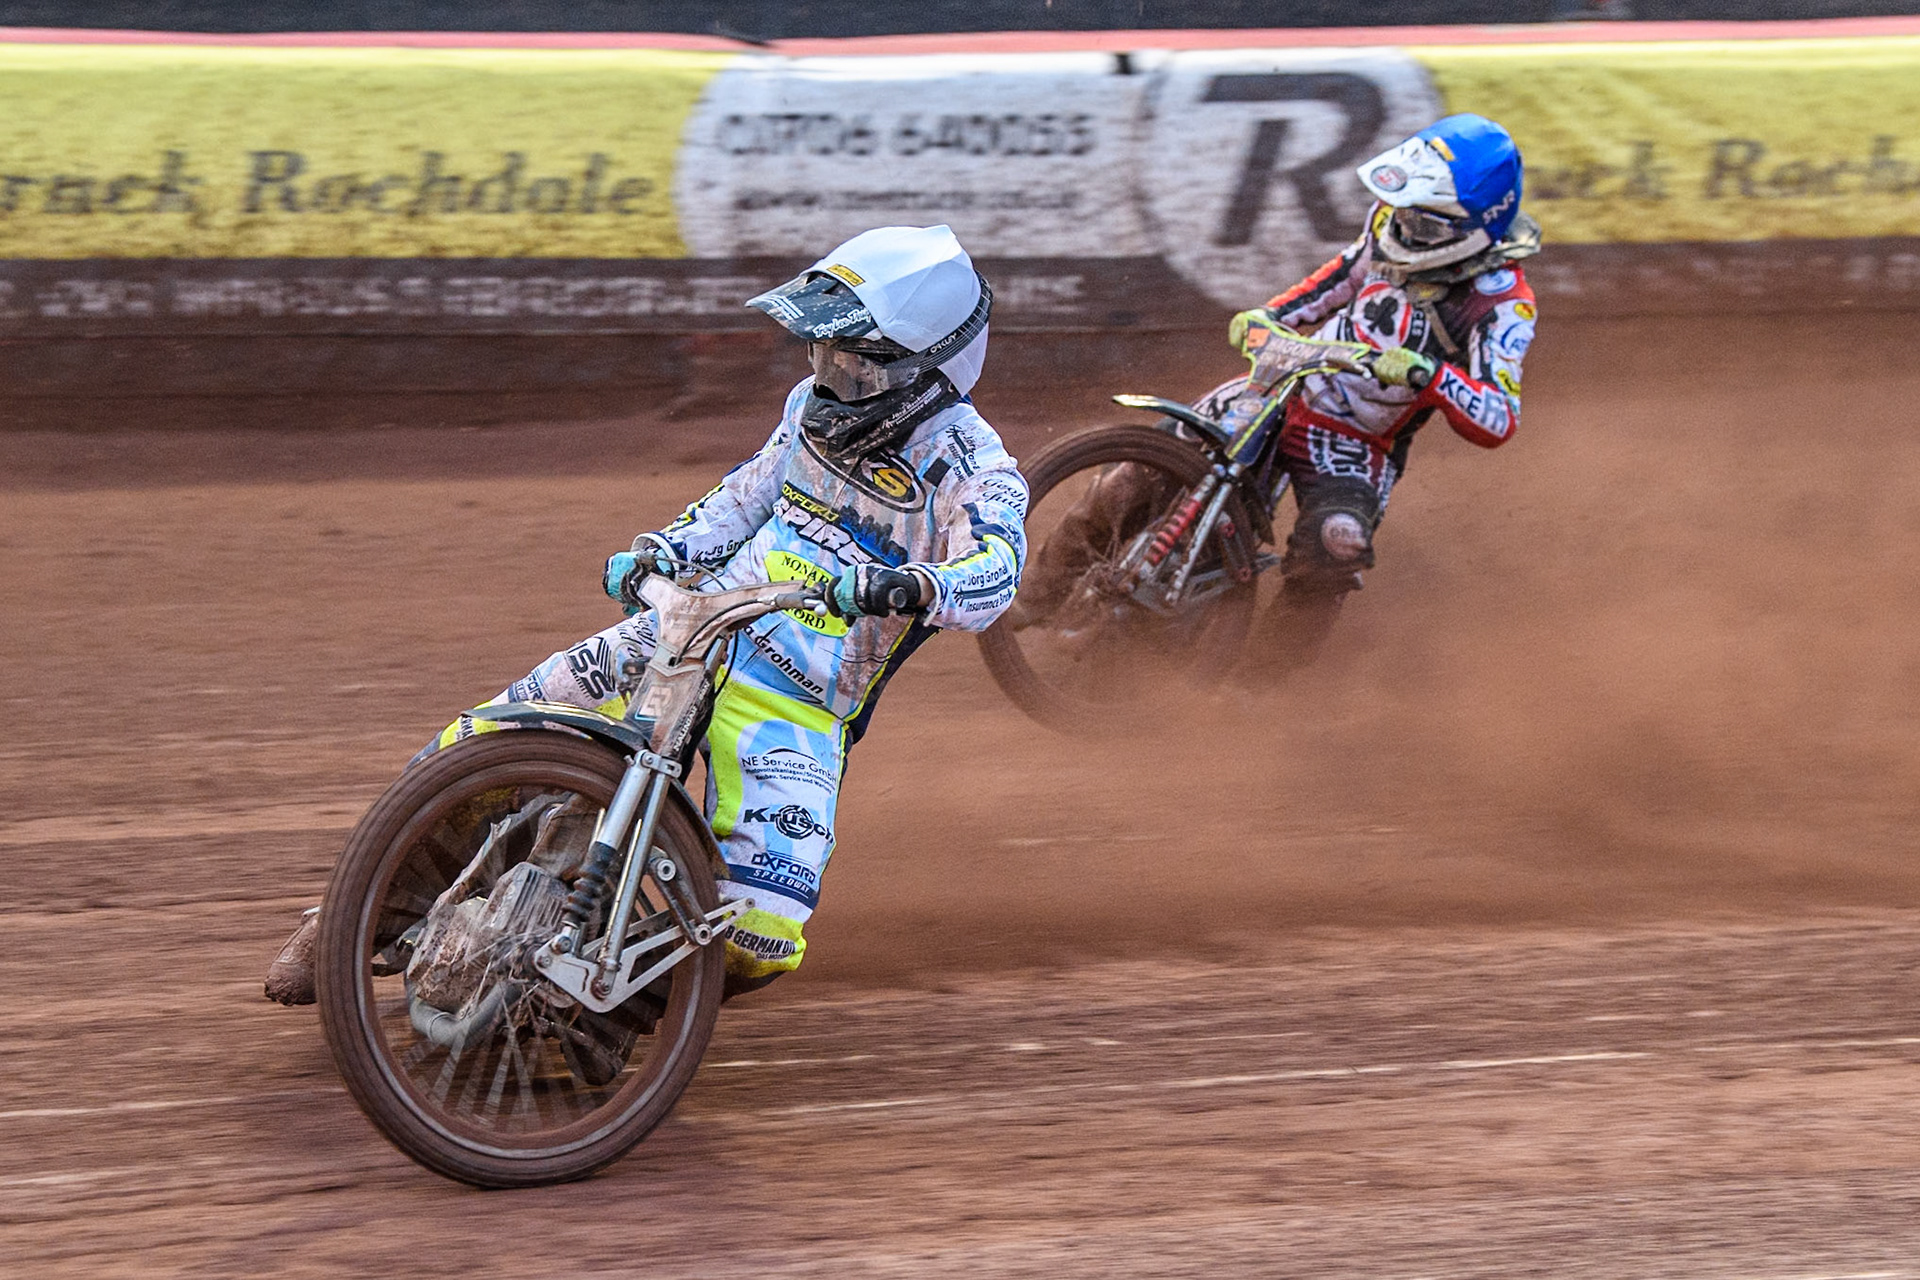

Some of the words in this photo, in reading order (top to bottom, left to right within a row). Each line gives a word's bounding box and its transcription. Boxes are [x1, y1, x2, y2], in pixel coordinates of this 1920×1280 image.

[1198, 72, 1384, 247] R
[241, 149, 655, 215] Rochdale
[930, 332, 957, 354] OAKLEY
[781, 483, 840, 522] OXFORD
[772, 496, 873, 566] SPIRE
[967, 569, 985, 588] Jörg
[789, 606, 826, 630] ORD
[740, 755, 760, 768] NE
[761, 755, 806, 771] Service
[742, 806, 835, 844] Krusch
[750, 851, 817, 885] OXFORD
[752, 868, 810, 893] SPEEDWAY
[733, 929, 784, 954] GERMAN
